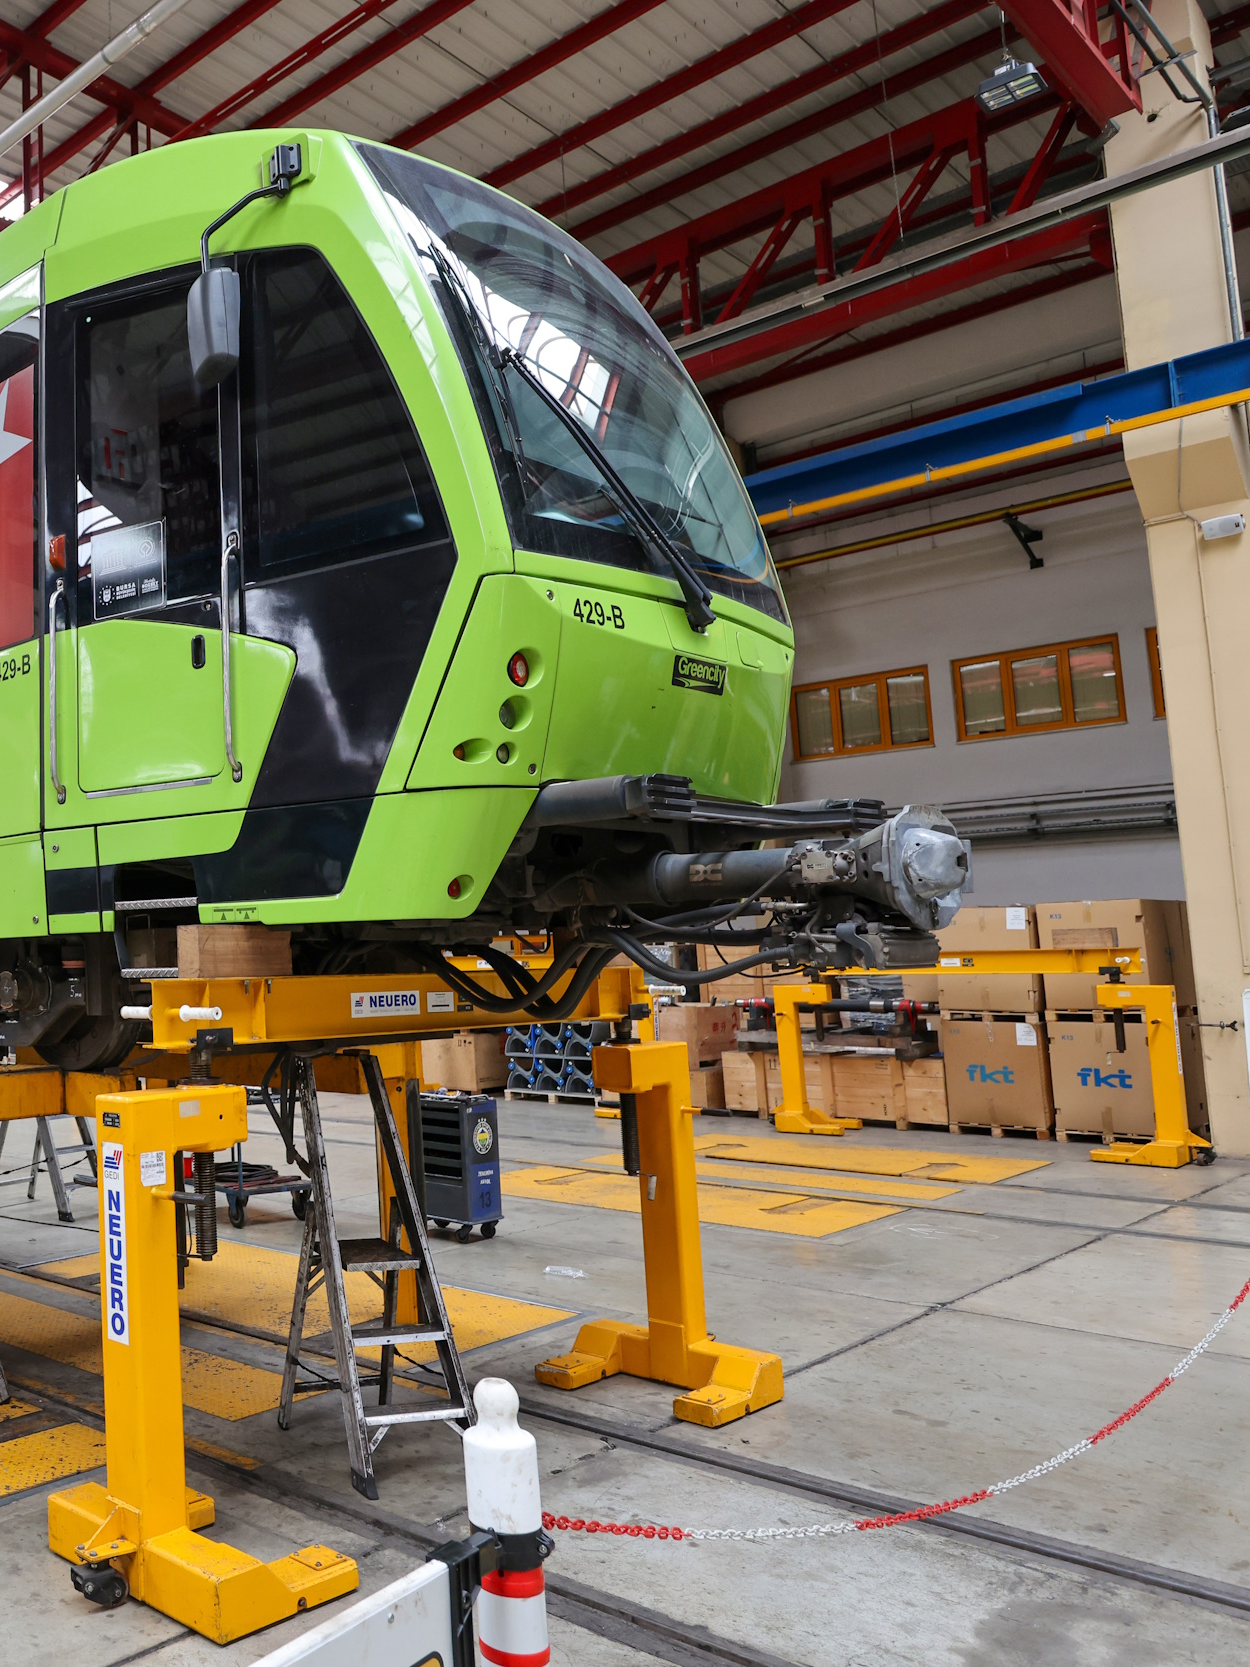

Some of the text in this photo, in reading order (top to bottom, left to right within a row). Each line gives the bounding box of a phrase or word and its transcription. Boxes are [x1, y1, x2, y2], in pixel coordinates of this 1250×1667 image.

[116, 582, 136, 592] BURSA
[574, 598, 625, 630] 429-B
[678, 656, 726, 688] Greencity
[369, 993, 417, 1008] NEUERO
[966, 1064, 1015, 1084] fkt
[1077, 1067, 1133, 1089] fkt
[104, 1169, 120, 1181] GEDI
[480, 1191, 492, 1209] 13
[108, 1189, 125, 1336] NEUERO
